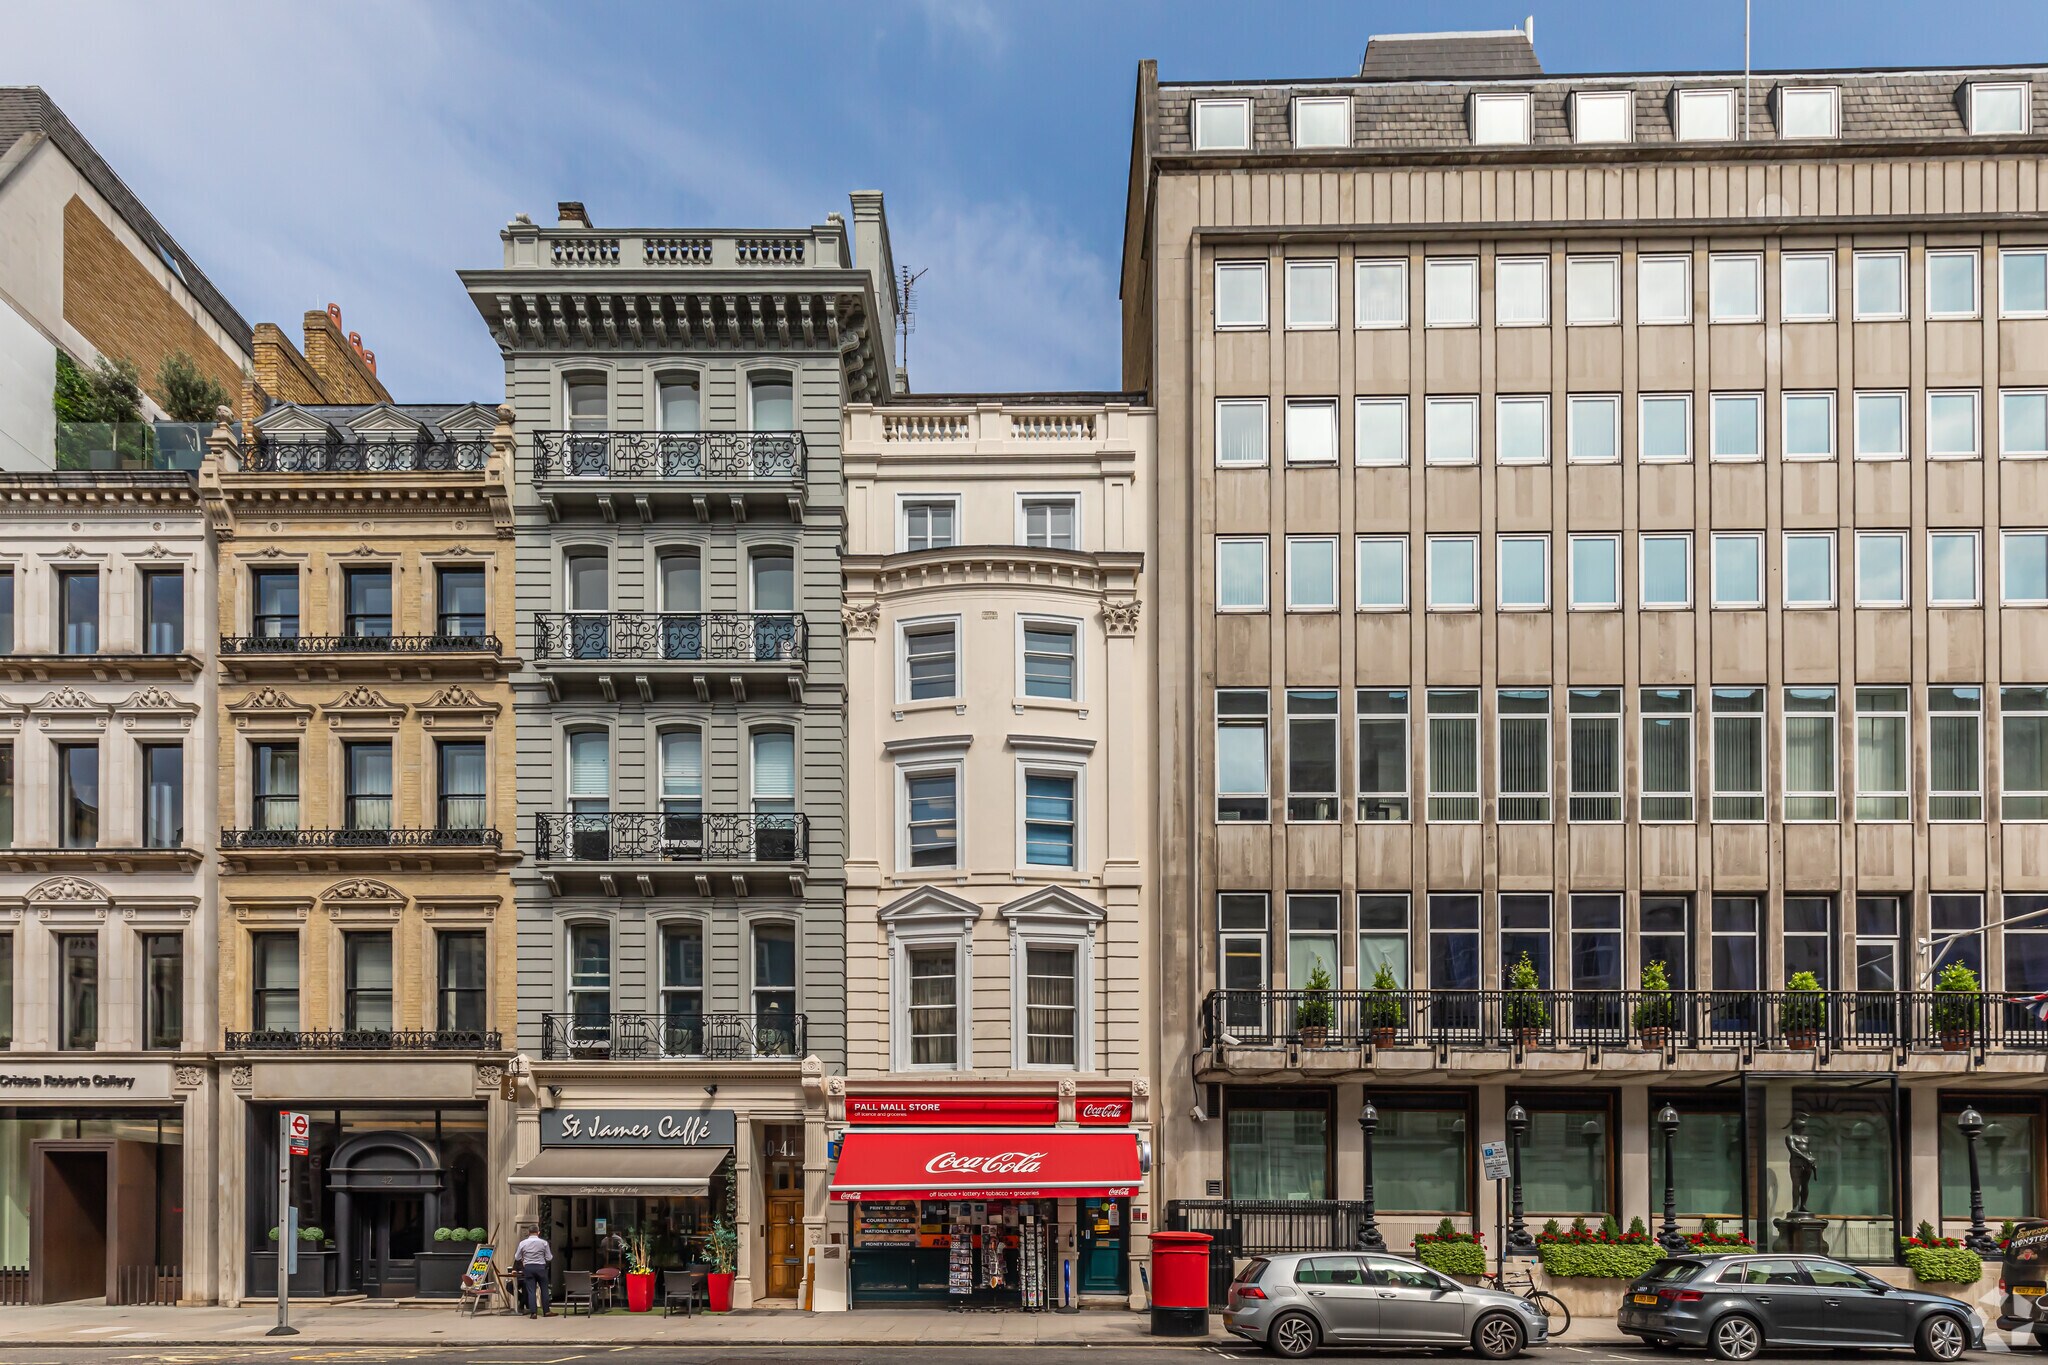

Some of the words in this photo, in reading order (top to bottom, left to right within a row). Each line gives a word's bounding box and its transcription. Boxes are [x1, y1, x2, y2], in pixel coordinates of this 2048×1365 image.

[43, 1074, 91, 1089] Roberts
[92, 1074, 136, 1090] Gallery
[854, 1103, 878, 1111] PALL
[880, 1103, 907, 1111] MALL
[908, 1103, 940, 1111] STORE
[1083, 1103, 1123, 1118] Coca-Cola
[561, 1113, 583, 1138] St
[588, 1114, 652, 1139] James
[657, 1114, 711, 1146] Caffé
[762, 1139, 796, 1157] 0-41
[925, 1151, 1049, 1174] Coca-Cola
[840, 1191, 861, 1200] Coca-Cola
[1013, 1189, 1040, 1197] groceries
[1108, 1187, 1130, 1196] Coca-Cola
[932, 1236, 950, 1246] Ria
